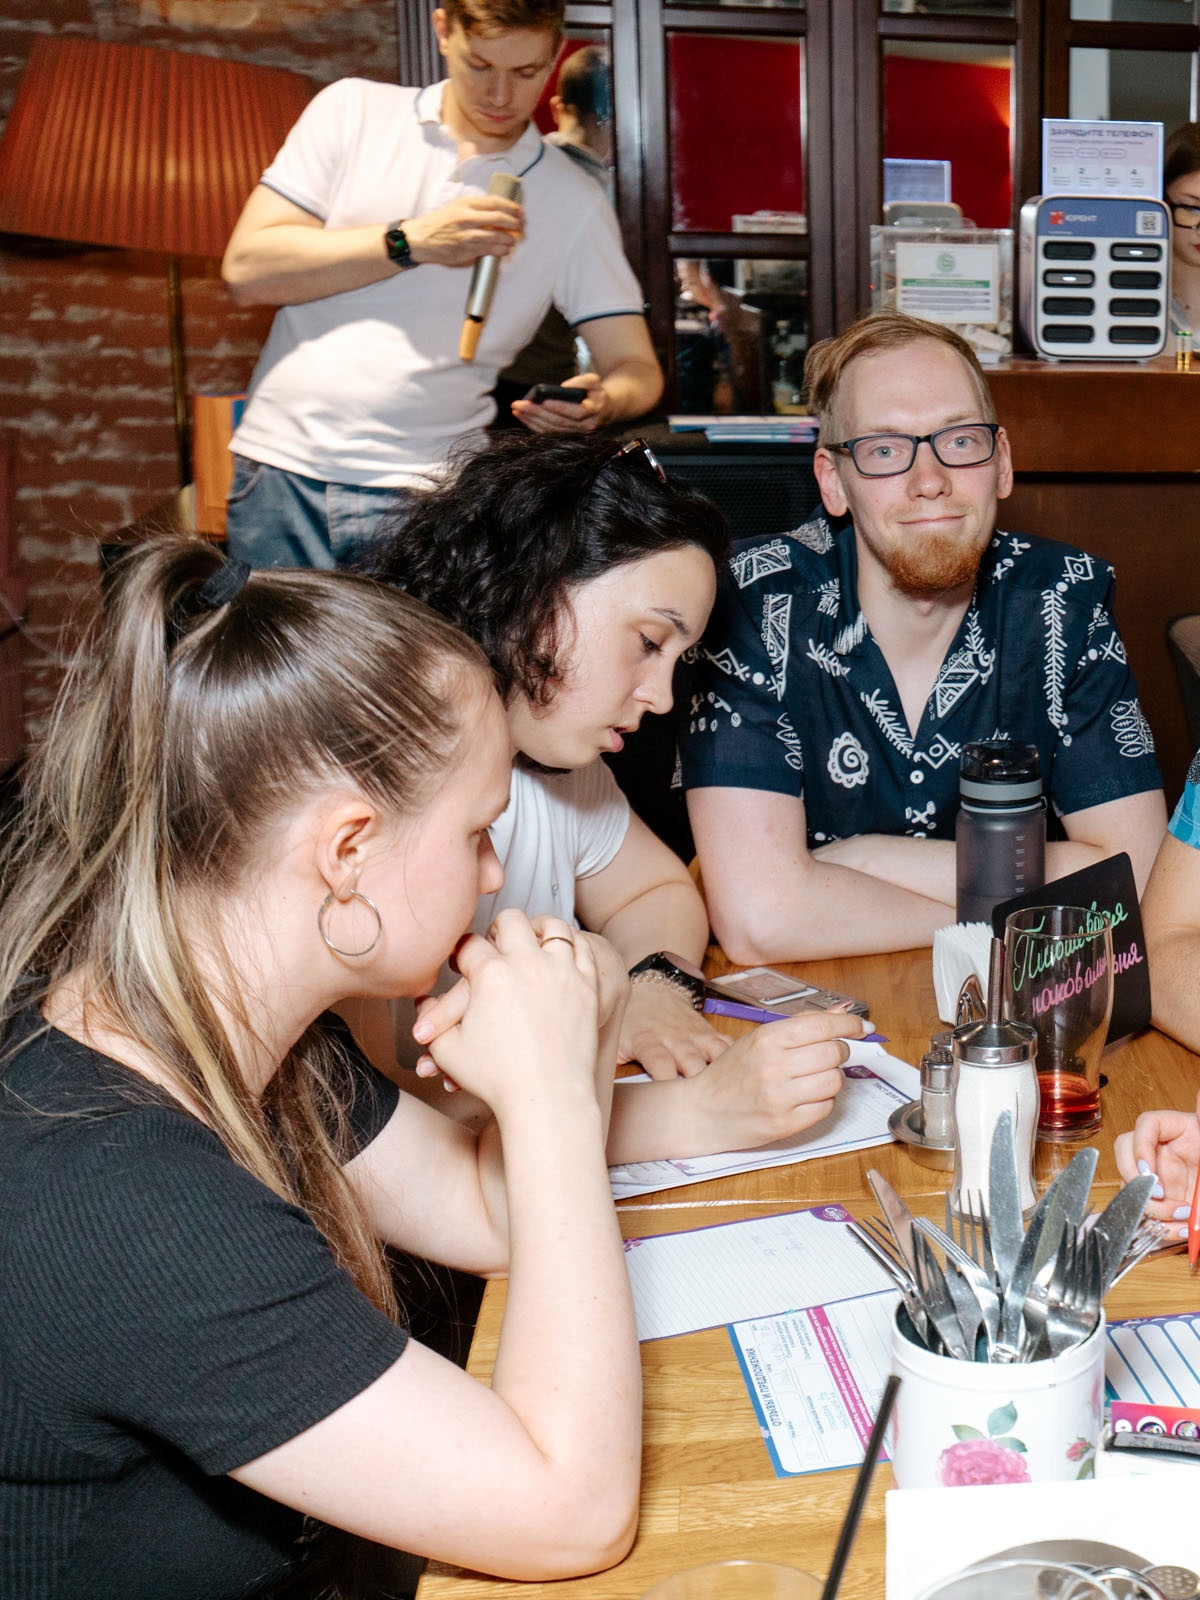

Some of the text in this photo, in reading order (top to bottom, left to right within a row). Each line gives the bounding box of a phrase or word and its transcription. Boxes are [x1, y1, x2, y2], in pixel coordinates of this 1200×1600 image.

[1049, 128, 1154, 138] ЗАРЯДИТЕ ТЕЛЕФОН
[746, 1347, 769, 1392] ПРЕДЛОЖЕНИЯ
[764, 1396, 782, 1427] ОТЗЫВЫ
